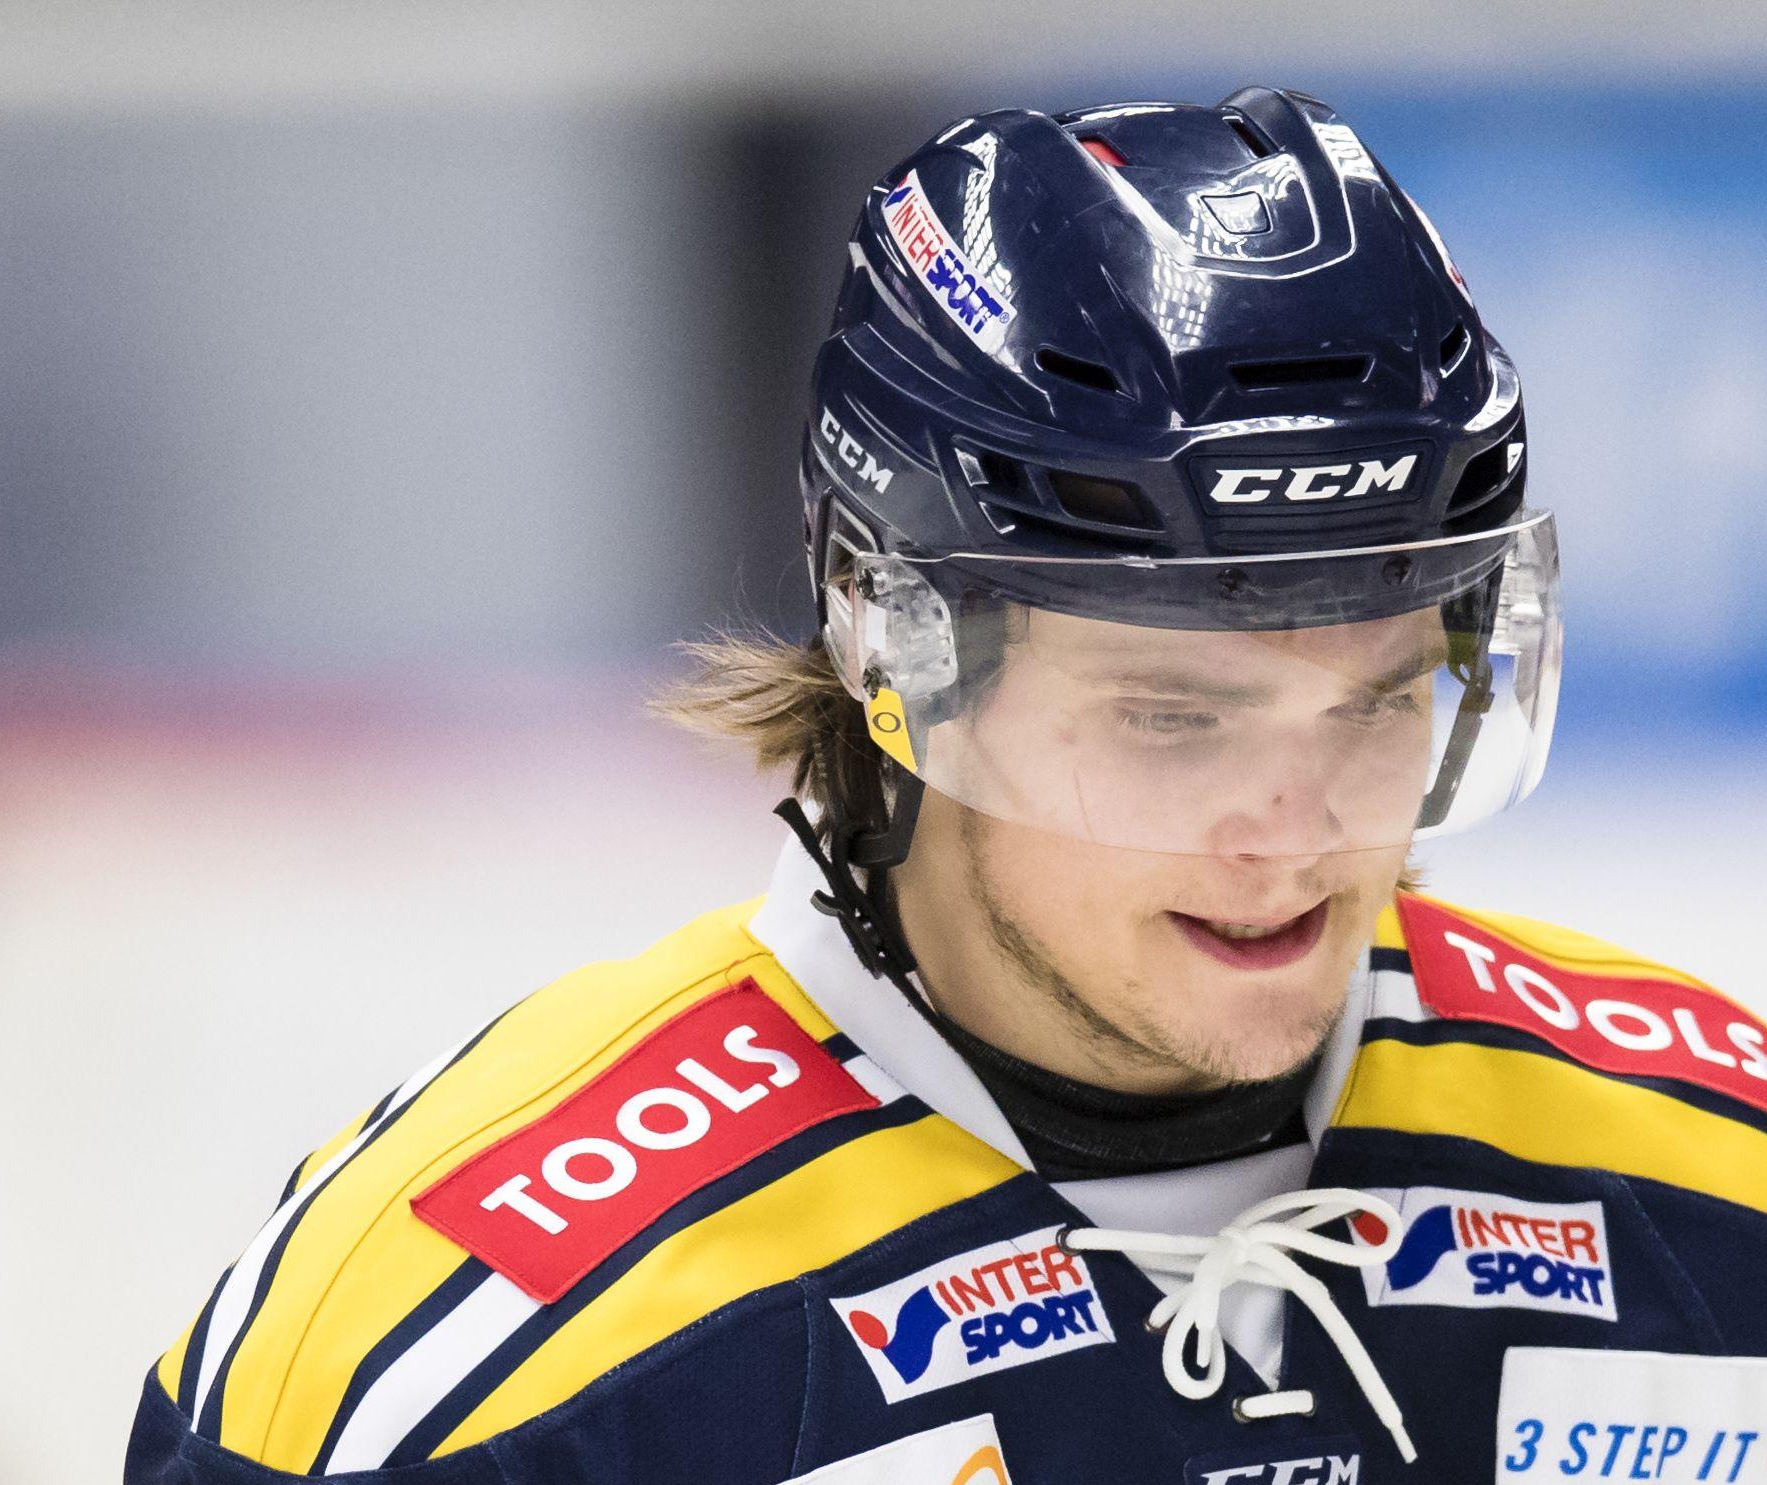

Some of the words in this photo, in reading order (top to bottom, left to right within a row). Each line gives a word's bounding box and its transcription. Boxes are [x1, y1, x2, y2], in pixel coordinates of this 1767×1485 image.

[820, 405, 894, 494] CCM
[1208, 454, 1419, 505] CCM
[480, 1025, 802, 1237] TOOLS
[1457, 1207, 1599, 1264] INTER
[936, 1244, 1083, 1316] INTER
[1466, 1250, 1605, 1307] SPORT
[960, 1289, 1098, 1366] SPORT
[1504, 1418, 1543, 1474] 3
[1559, 1420, 1683, 1481] STEP
[1697, 1429, 1759, 1485] IT
